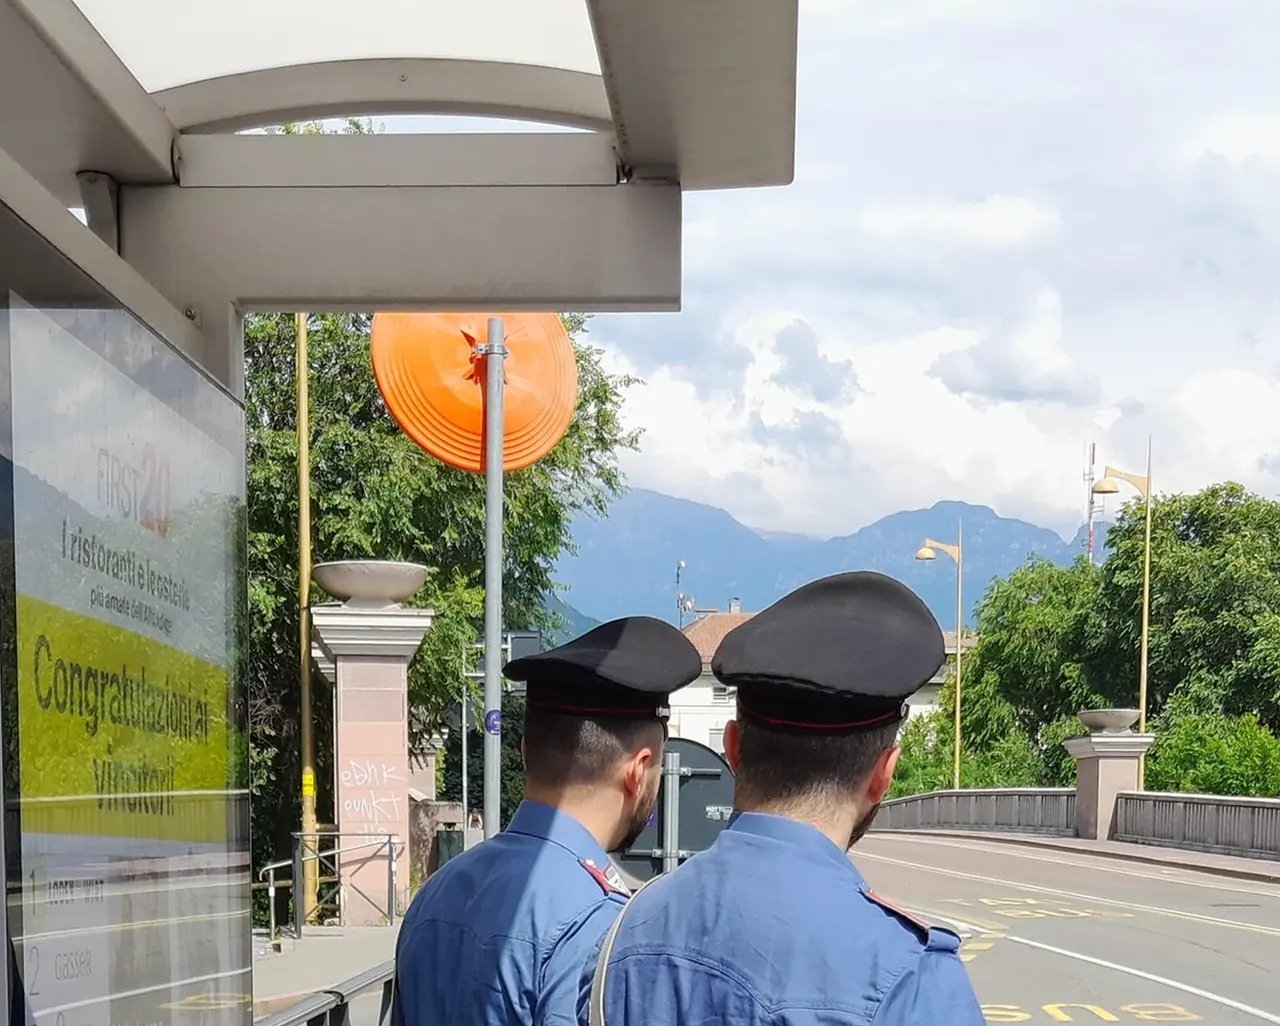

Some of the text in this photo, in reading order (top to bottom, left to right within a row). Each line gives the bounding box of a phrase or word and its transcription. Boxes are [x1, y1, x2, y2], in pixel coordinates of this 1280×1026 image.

[62, 519, 67, 558] I
[70, 527, 135, 587] ristoranti
[146, 559, 156, 597] le
[157, 573, 190, 611] osterie
[90, 585, 104, 608] più
[105, 590, 130, 614] amate
[34, 634, 208, 745] Congratulazioni ai
[92, 744, 175, 816] vincitori!
[29, 868, 35, 916] 1
[29, 946, 39, 996] 2
[983, 1003, 1204, 1022] BUS
